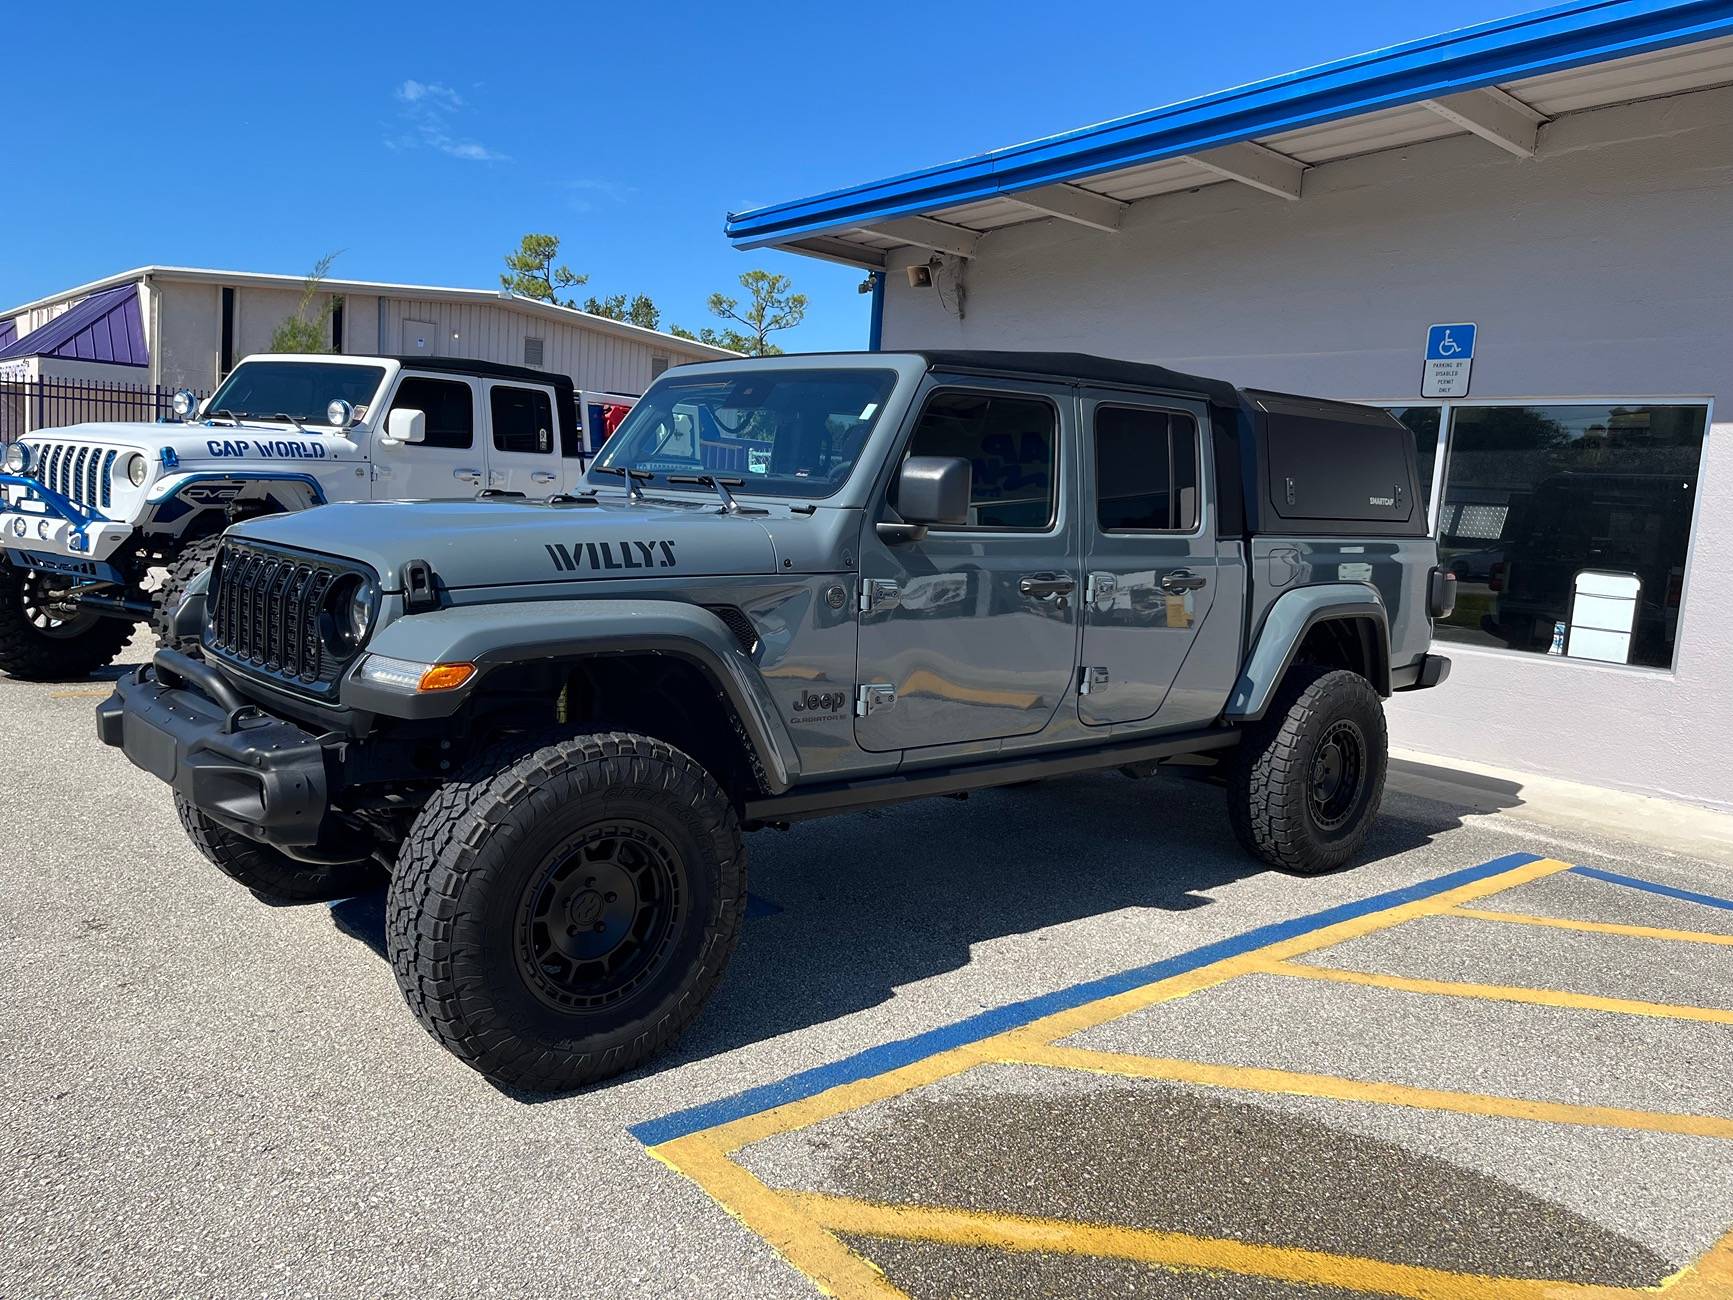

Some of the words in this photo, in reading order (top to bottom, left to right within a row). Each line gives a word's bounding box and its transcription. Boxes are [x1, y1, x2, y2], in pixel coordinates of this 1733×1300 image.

[206, 440, 249, 457] CAP
[253, 440, 326, 458] WORLD
[1369, 496, 1394, 506] SMARTCAP
[544, 540, 677, 571] WILLYS
[792, 690, 846, 712] Jeep
